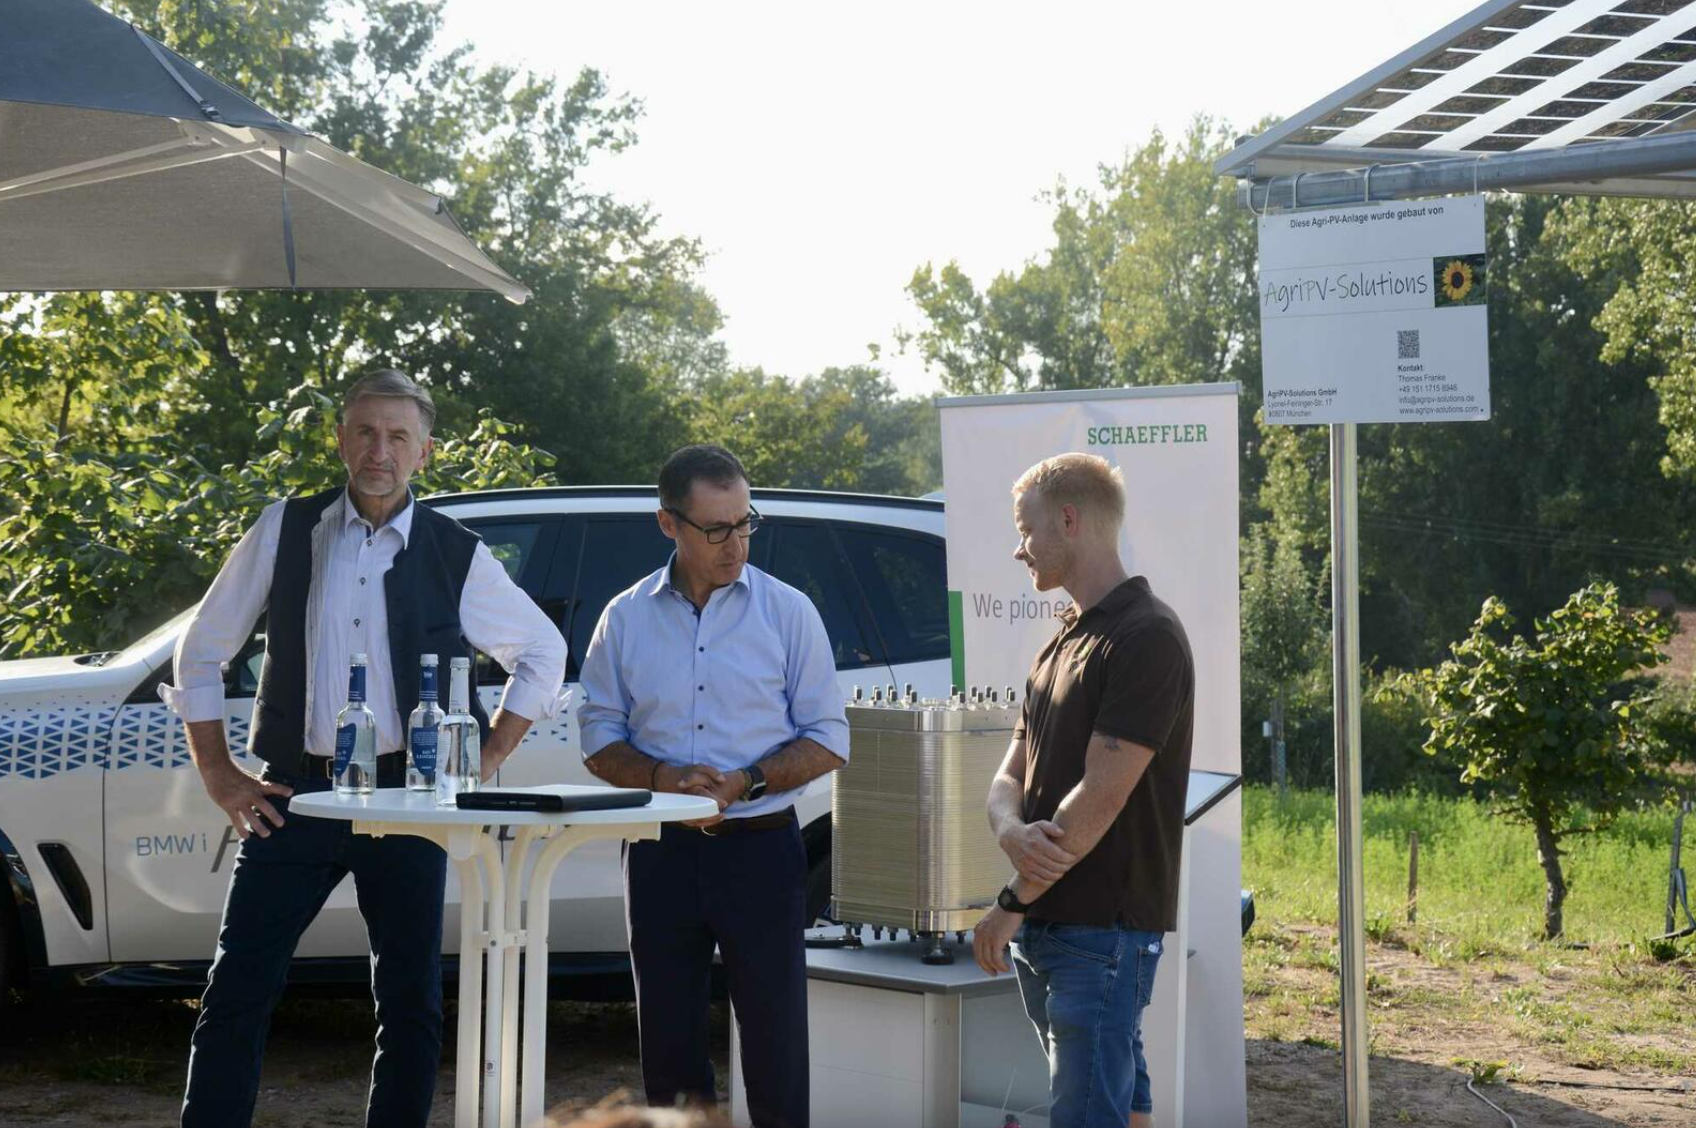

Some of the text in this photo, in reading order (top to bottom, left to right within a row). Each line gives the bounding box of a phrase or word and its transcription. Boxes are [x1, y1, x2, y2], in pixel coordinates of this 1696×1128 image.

[1290, 206, 1444, 228] Diese Agri-PV-Anlage wurde gebaut von
[1263, 271, 1428, 312] AgriPV-Solutions
[1268, 388, 1337, 398] AgriPV-Solutions GmbH
[1399, 395, 1474, 405] info@agripv-solutions.de
[1399, 406, 1478, 415] www.agripv-solutions.com
[1088, 424, 1208, 445] SCHAEFFLER
[973, 593, 1073, 625] We pione
[136, 833, 195, 857] BMW
[202, 832, 208, 853] i
